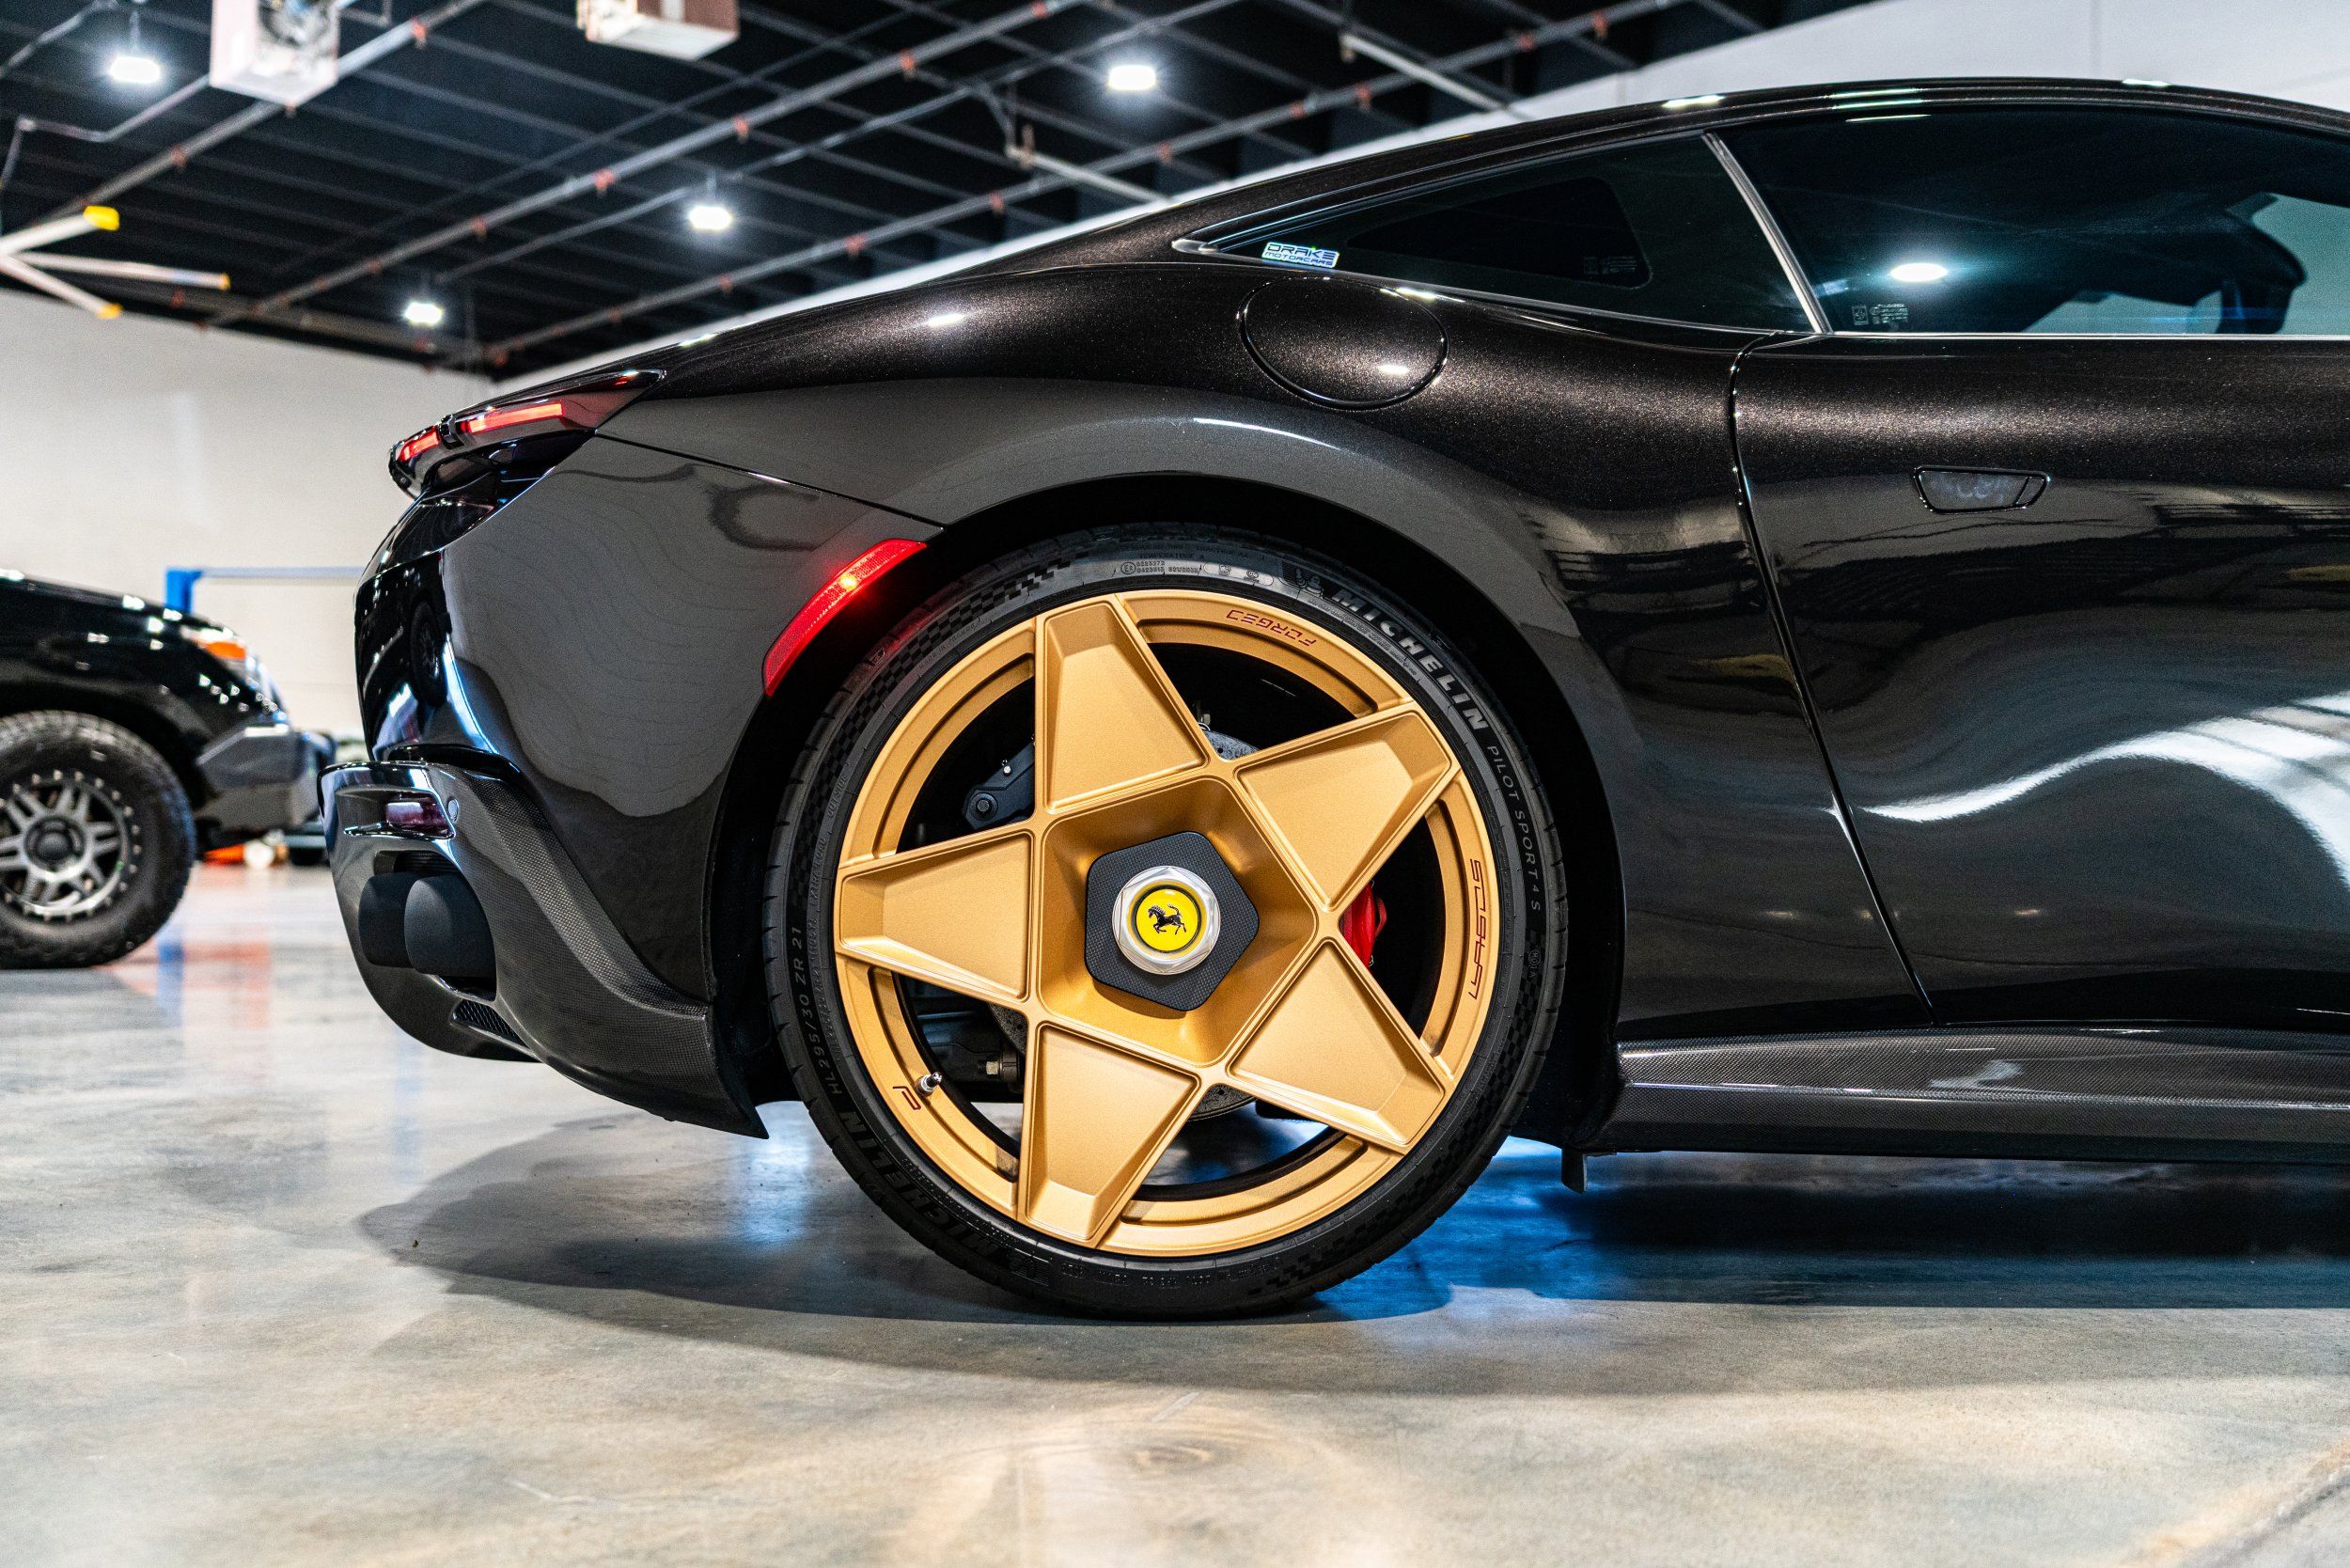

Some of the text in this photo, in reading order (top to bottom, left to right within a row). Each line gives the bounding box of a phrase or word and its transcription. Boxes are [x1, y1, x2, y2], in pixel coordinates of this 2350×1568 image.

[1264, 251, 1333, 266] MOTORCARS
[1267, 243, 1336, 259] DRAKE
[1226, 609, 1317, 647] FORGED
[1331, 588, 1489, 730] MICHELIN
[1486, 745, 1519, 800] PILOT
[1514, 810, 1539, 880] SPORT
[1531, 884, 1540, 893] 4
[1531, 900, 1541, 911] S
[791, 927, 803, 949] 21
[794, 959, 807, 987] ZR
